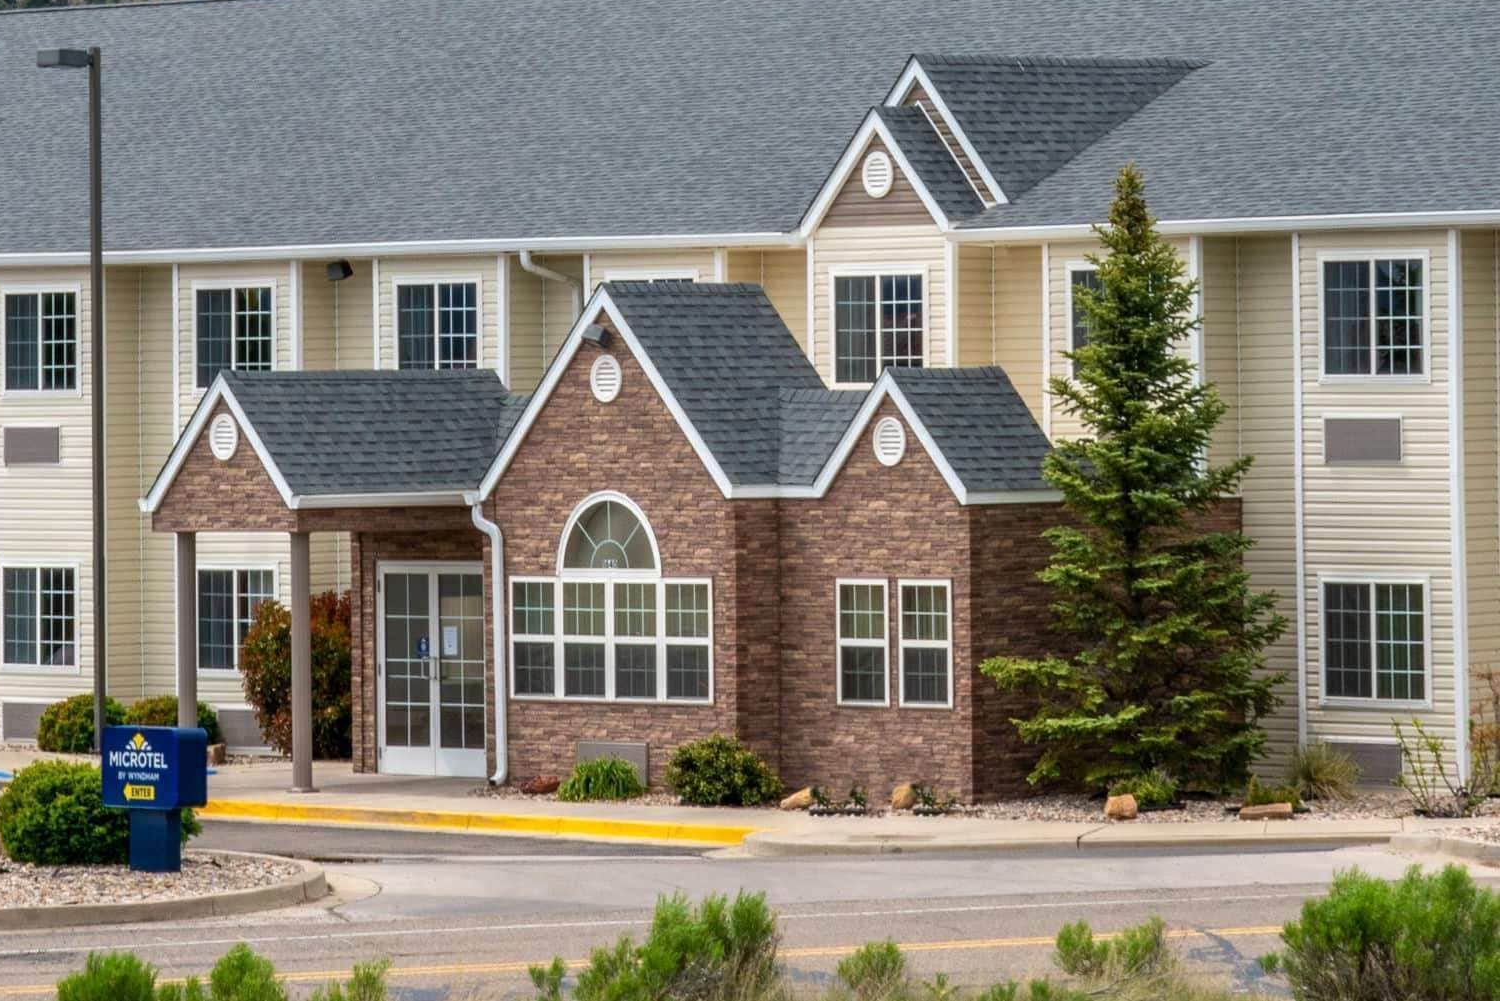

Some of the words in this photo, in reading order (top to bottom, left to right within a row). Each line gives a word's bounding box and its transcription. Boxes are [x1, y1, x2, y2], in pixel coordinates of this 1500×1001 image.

[109, 751, 168, 769] MICROTEL
[117, 771, 126, 781] BY
[128, 771, 160, 781] WYNDHAM
[131, 787, 151, 797] ENTER
